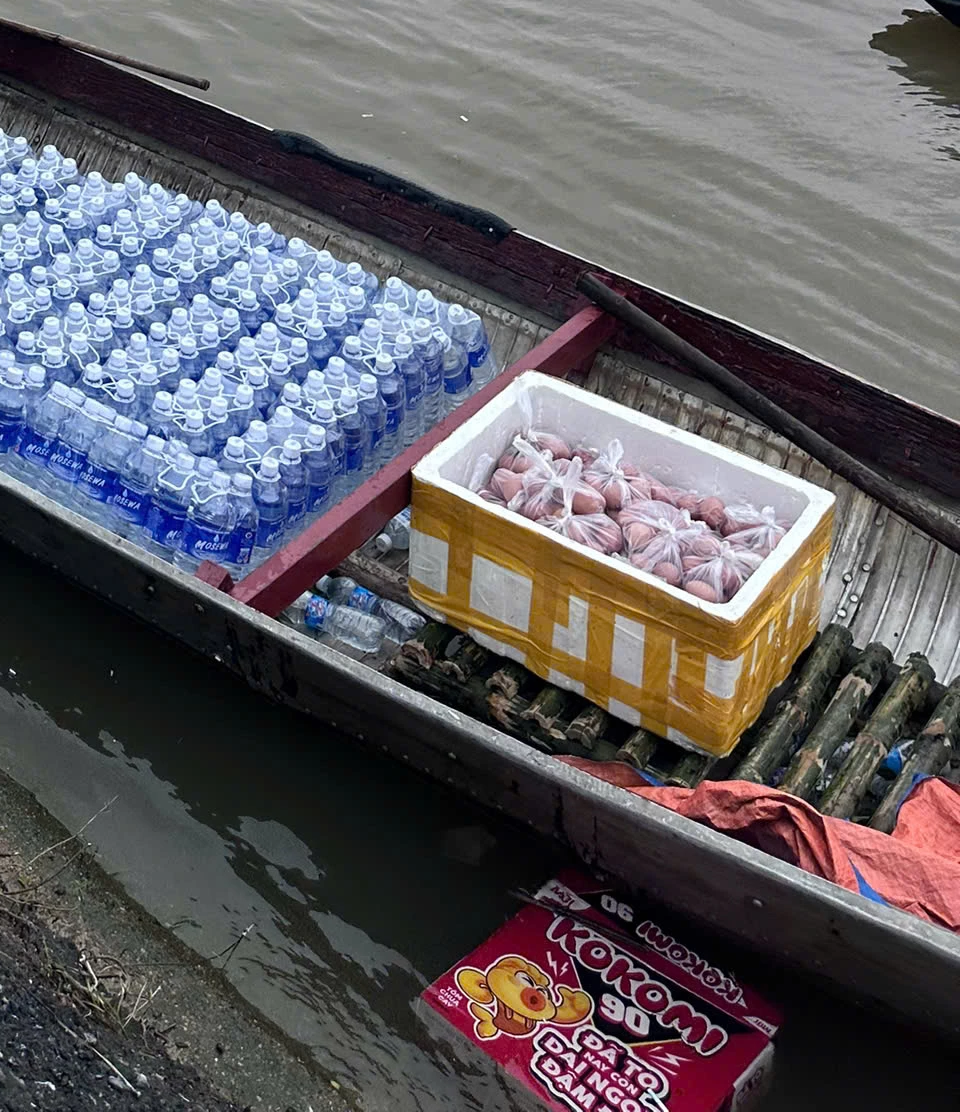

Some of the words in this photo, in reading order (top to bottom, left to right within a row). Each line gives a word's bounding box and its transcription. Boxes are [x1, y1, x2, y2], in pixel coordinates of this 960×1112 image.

[600, 893, 635, 923] 90
[545, 915, 729, 1057] KOKOMI
[635, 920, 745, 1005] KOKOMI
[599, 993, 651, 1037] 90
[544, 1036, 587, 1075] DAI
[581, 1033, 624, 1064] ĐÃ
[623, 1059, 660, 1091] TO
[583, 1051, 609, 1072] NAY
[541, 1056, 596, 1110] ĐẬM
